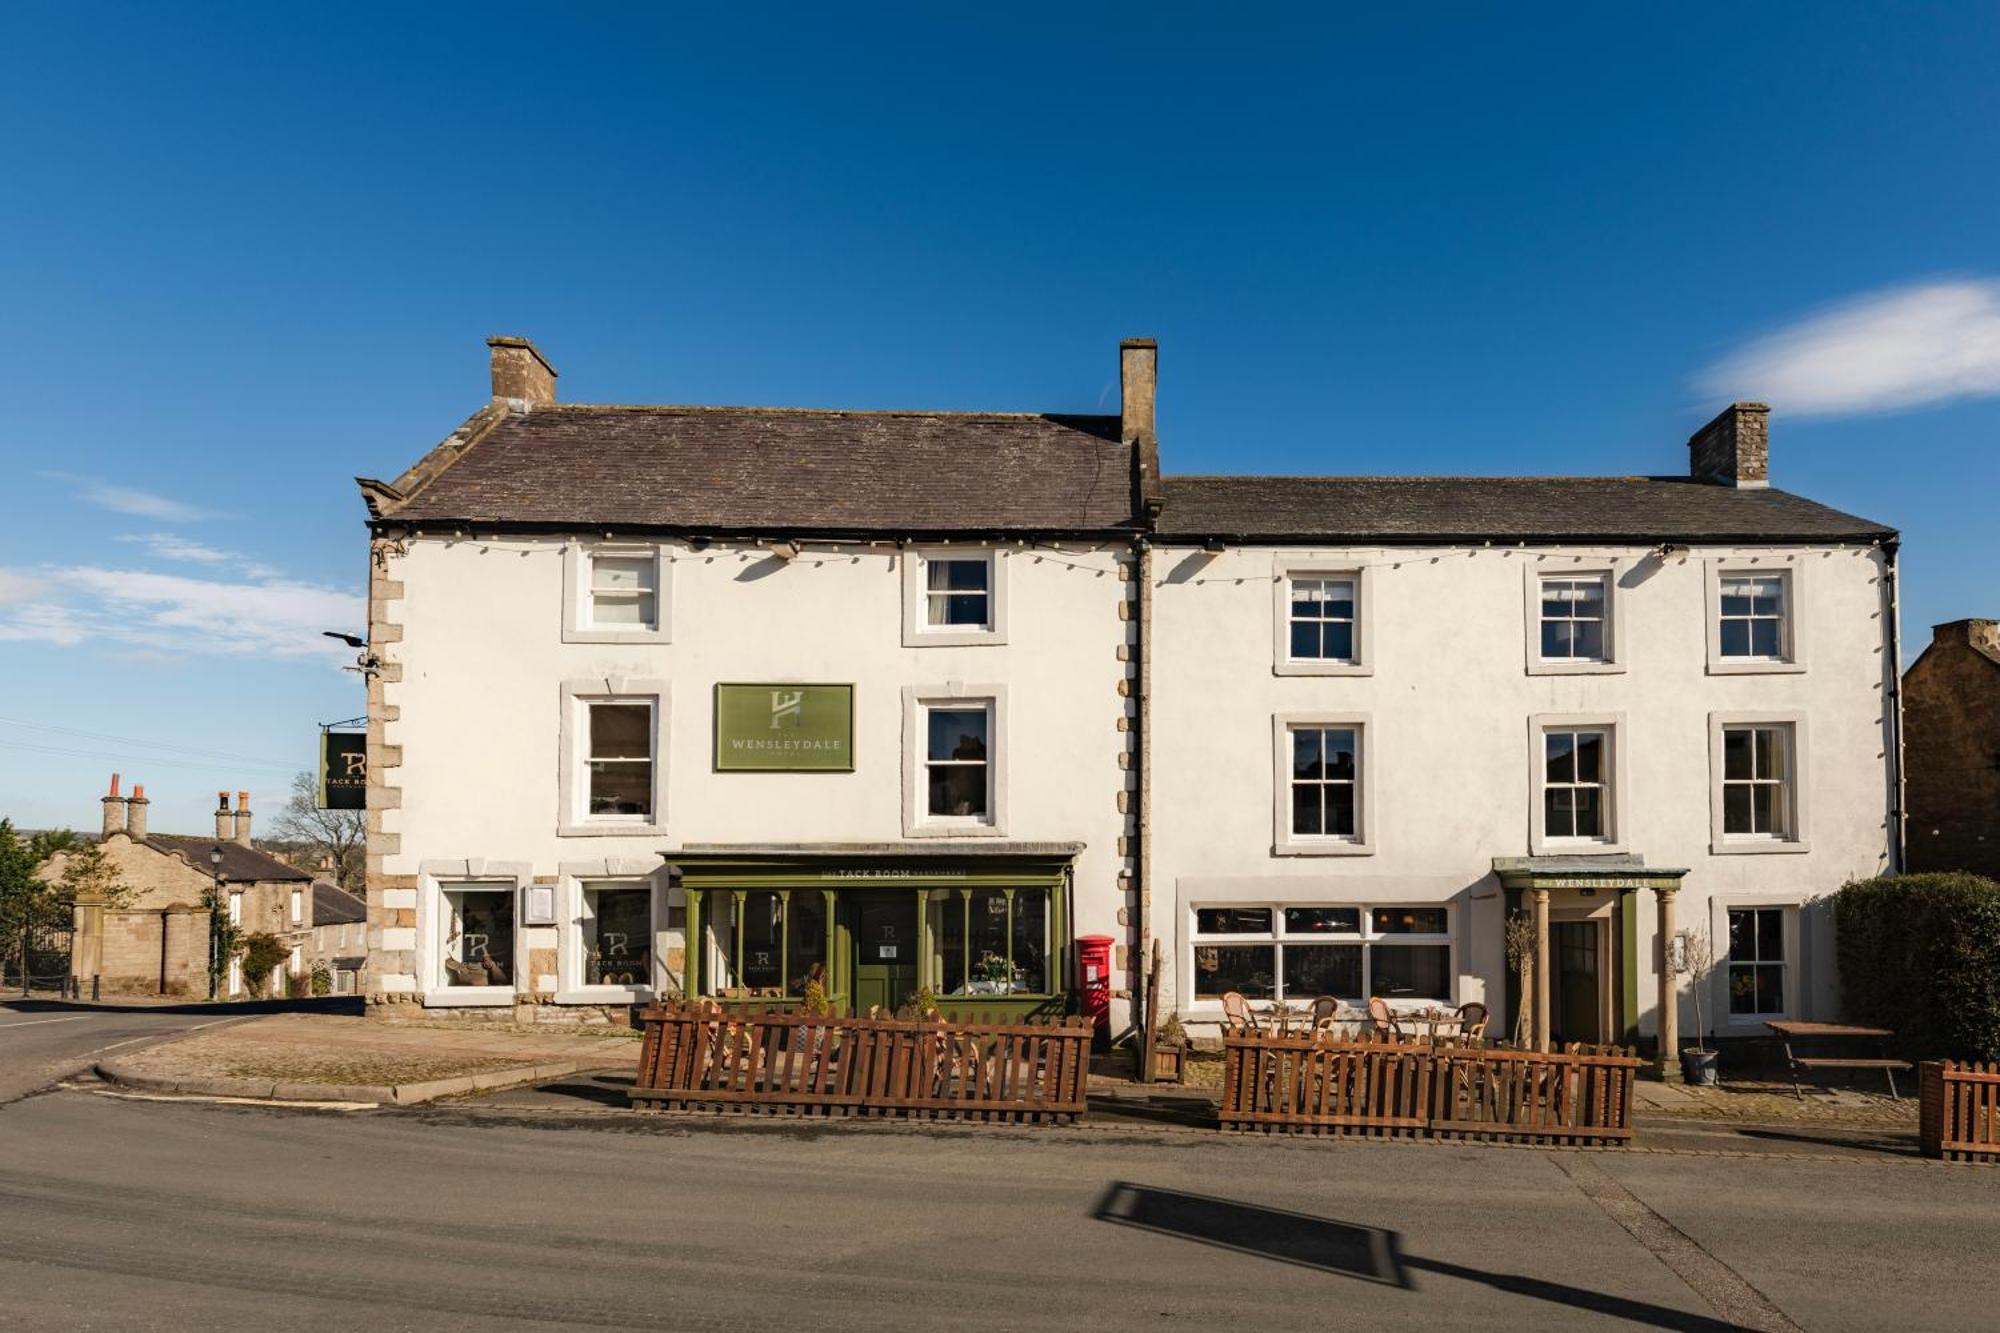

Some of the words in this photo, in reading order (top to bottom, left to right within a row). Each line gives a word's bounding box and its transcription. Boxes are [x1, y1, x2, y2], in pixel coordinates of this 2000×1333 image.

[732, 739, 841, 749] WENSLEYDALE
[839, 869, 869, 878] TACK
[874, 869, 910, 878] ROOM
[1555, 879, 1649, 888] WENSLEYDALE
